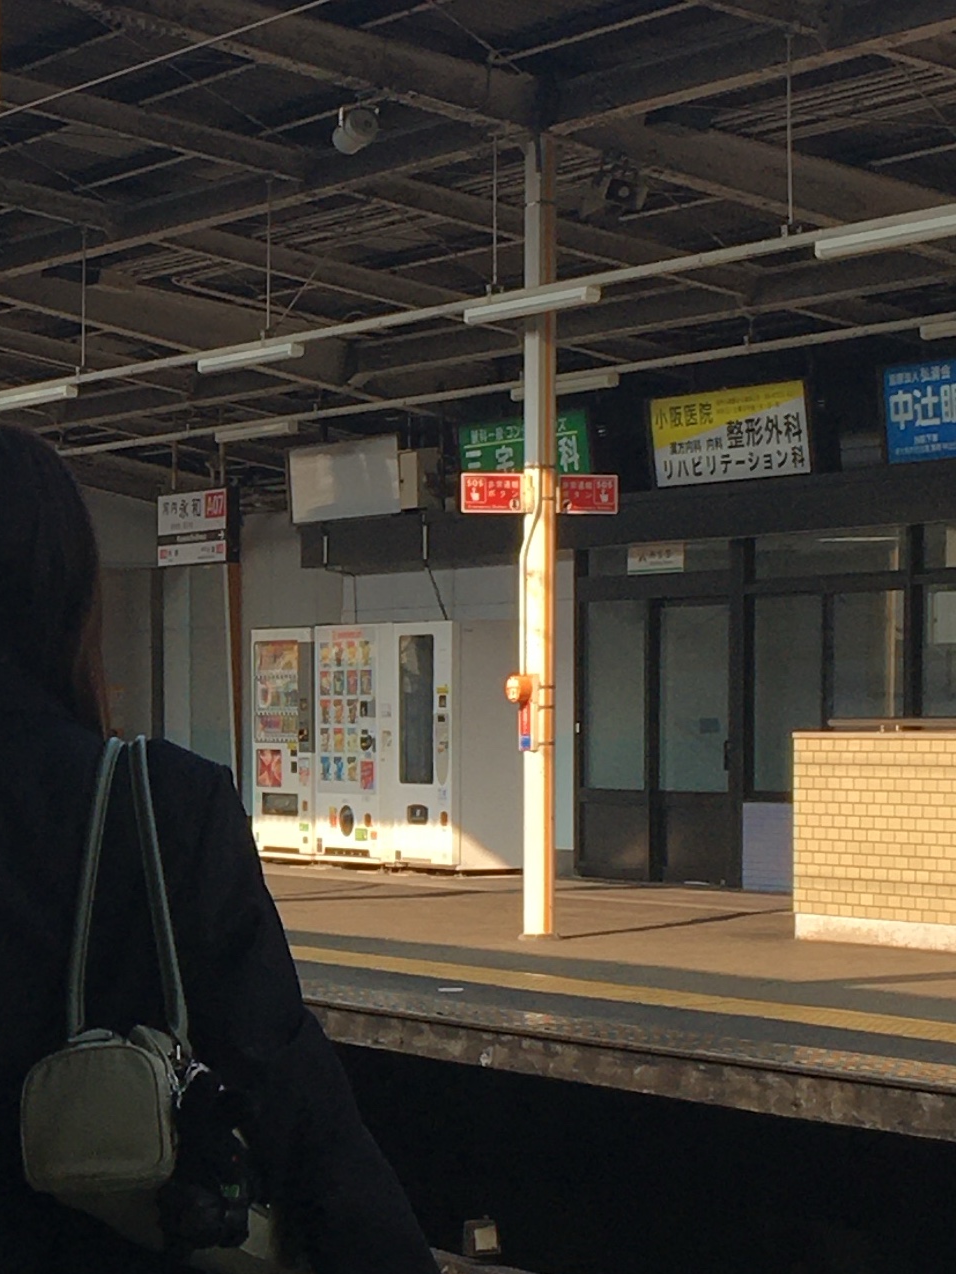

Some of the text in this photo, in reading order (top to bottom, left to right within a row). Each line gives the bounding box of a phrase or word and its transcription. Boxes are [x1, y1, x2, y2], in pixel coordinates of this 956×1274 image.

[654, 402, 714, 430] 小阪医院
[726, 411, 803, 450] 整形外科
[662, 444, 806, 480] リハビリテーション科
